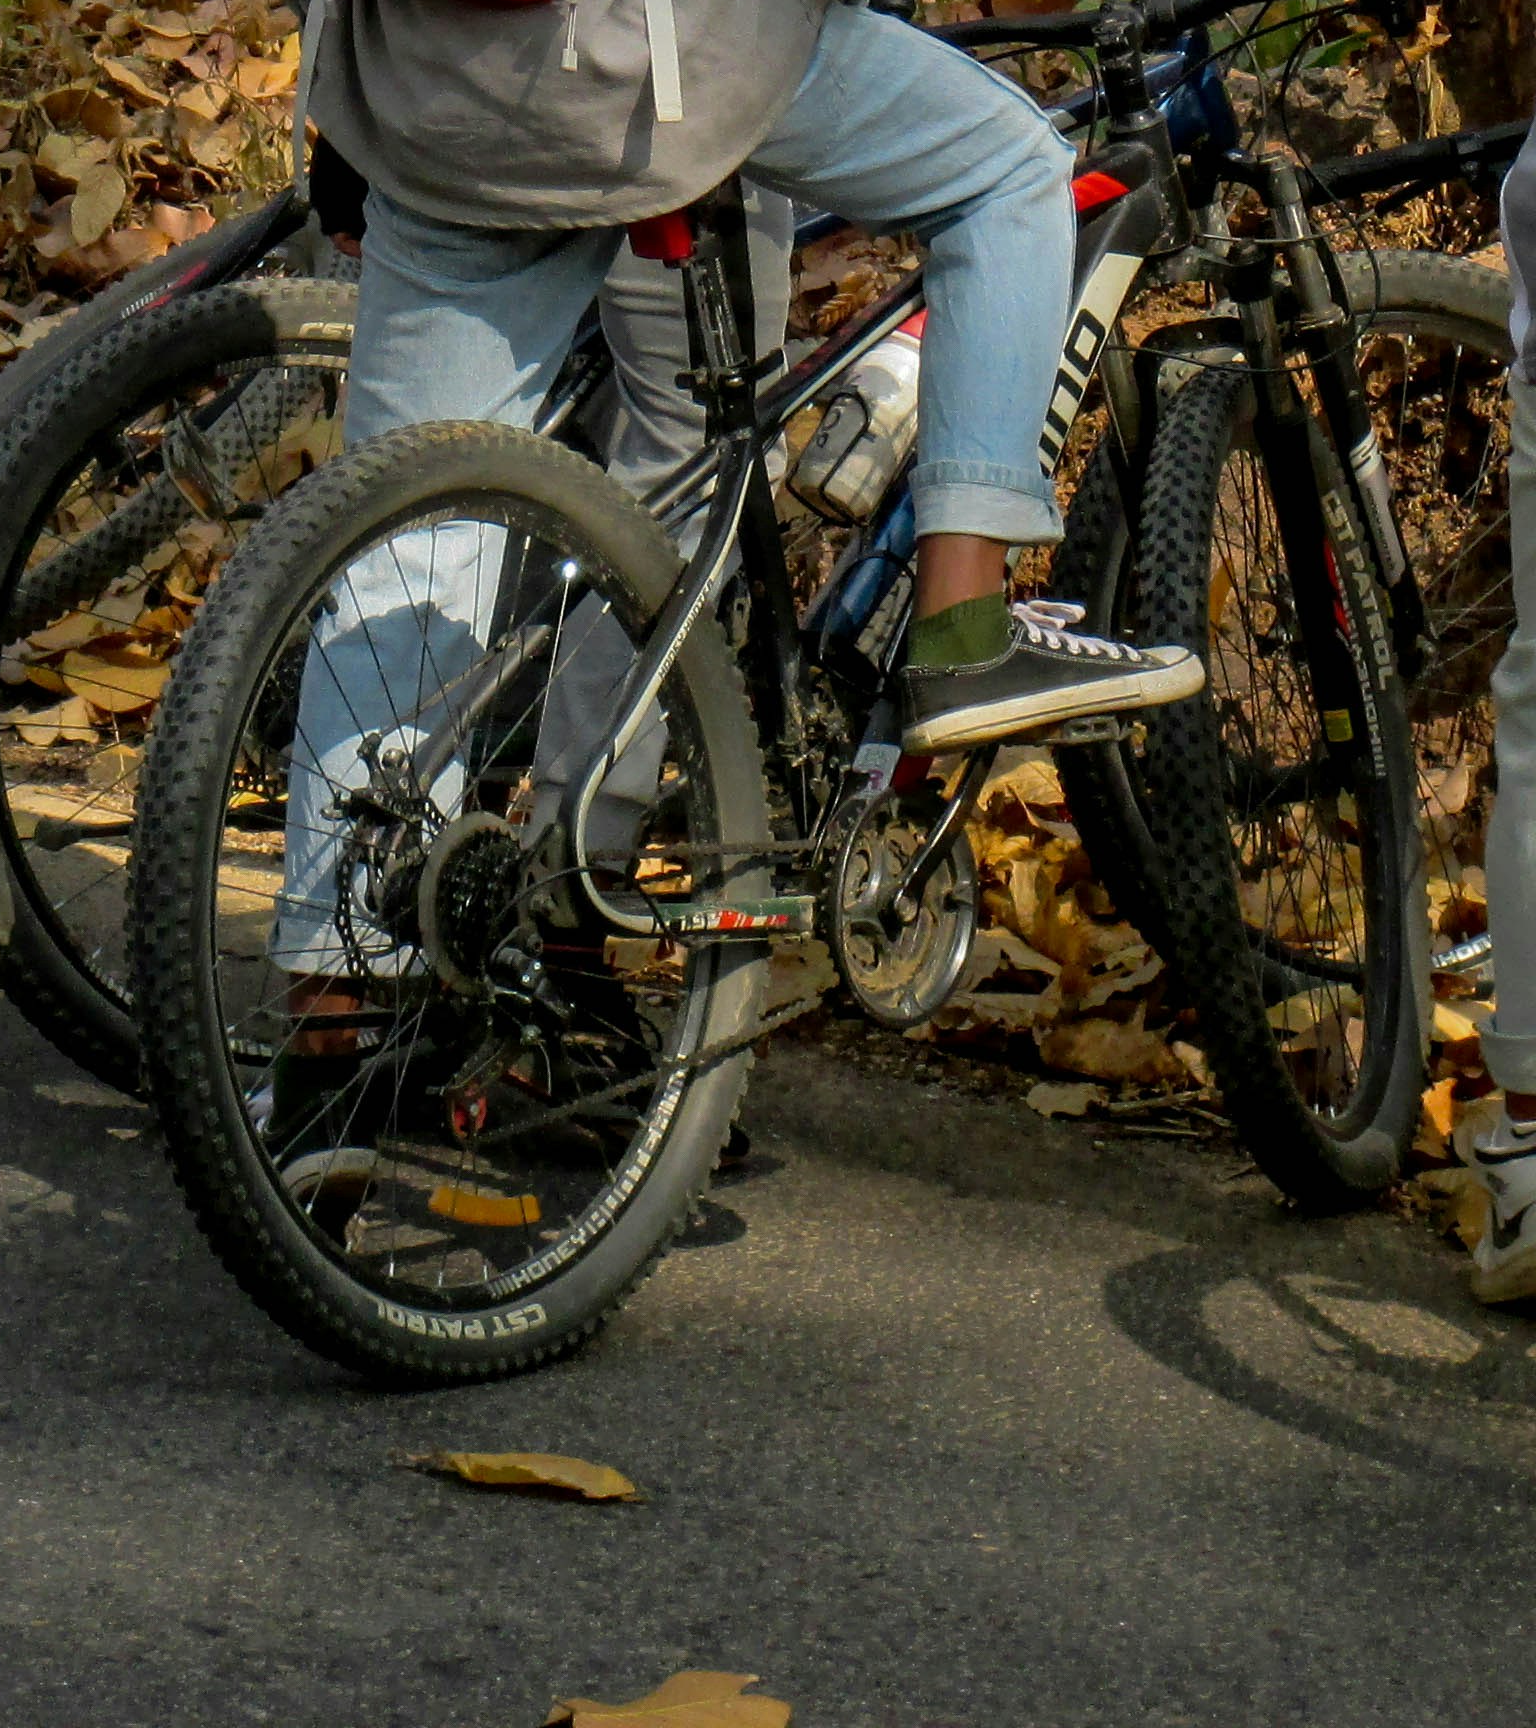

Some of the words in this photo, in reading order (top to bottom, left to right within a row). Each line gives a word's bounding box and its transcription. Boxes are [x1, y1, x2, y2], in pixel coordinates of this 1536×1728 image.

[1321, 488, 1357, 542] CST
[1345, 546, 1394, 691] PATROL
[377, 1301, 486, 1339] PATROL
[492, 1303, 548, 1339] CST
